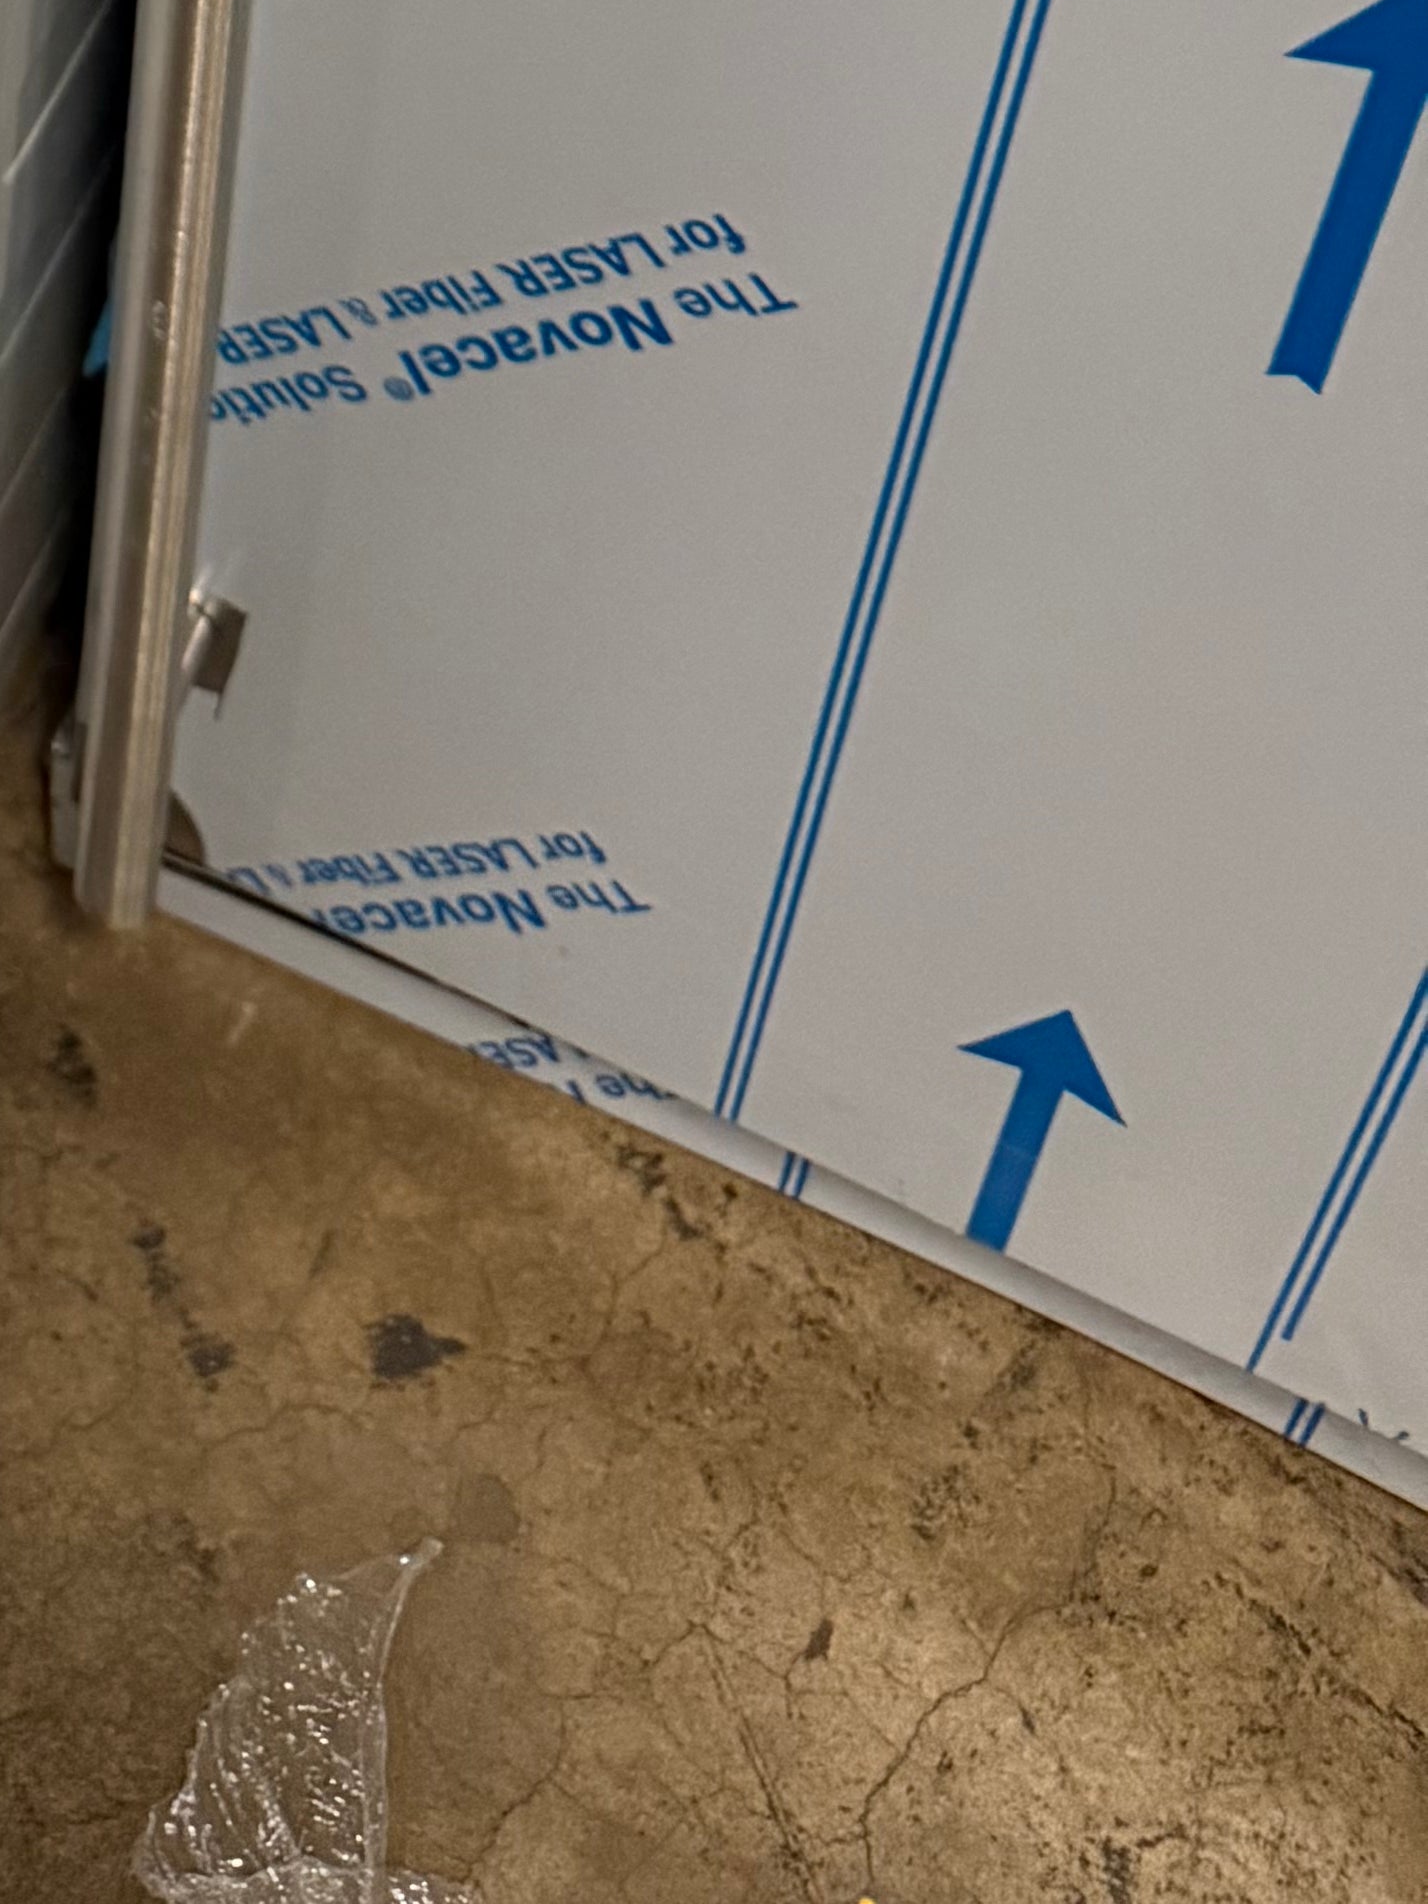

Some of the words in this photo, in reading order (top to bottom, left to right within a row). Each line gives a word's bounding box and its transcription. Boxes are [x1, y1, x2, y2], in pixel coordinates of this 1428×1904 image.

[664, 213, 748, 261] for
[496, 231, 666, 299] LASER
[379, 267, 504, 324] Fiber
[677, 270, 799, 321] The
[295, 850, 403, 887] Fiber
[405, 837, 542, 879] LASER
[540, 829, 608, 865] for
[544, 878, 652, 916] The
